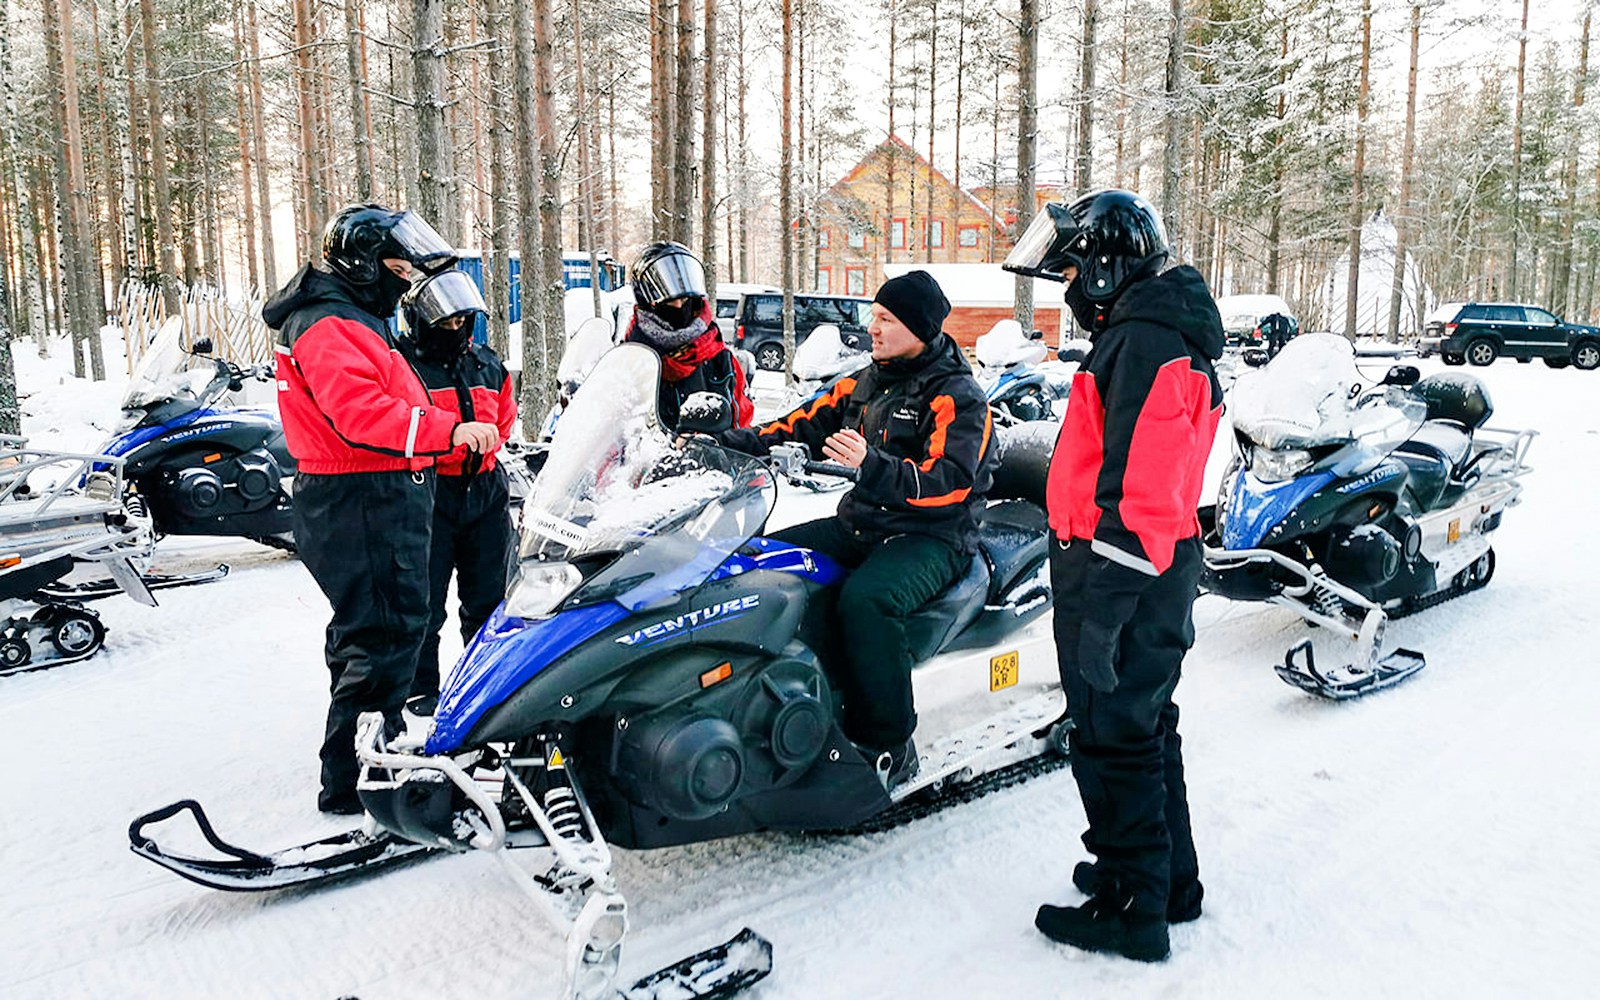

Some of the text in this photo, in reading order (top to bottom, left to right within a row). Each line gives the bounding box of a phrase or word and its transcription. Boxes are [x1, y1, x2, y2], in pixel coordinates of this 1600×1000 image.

[1347, 382, 1362, 400] 9
[614, 594, 760, 646] VENTURE
[995, 656, 1015, 673] 628
[994, 673, 1008, 687] AR
